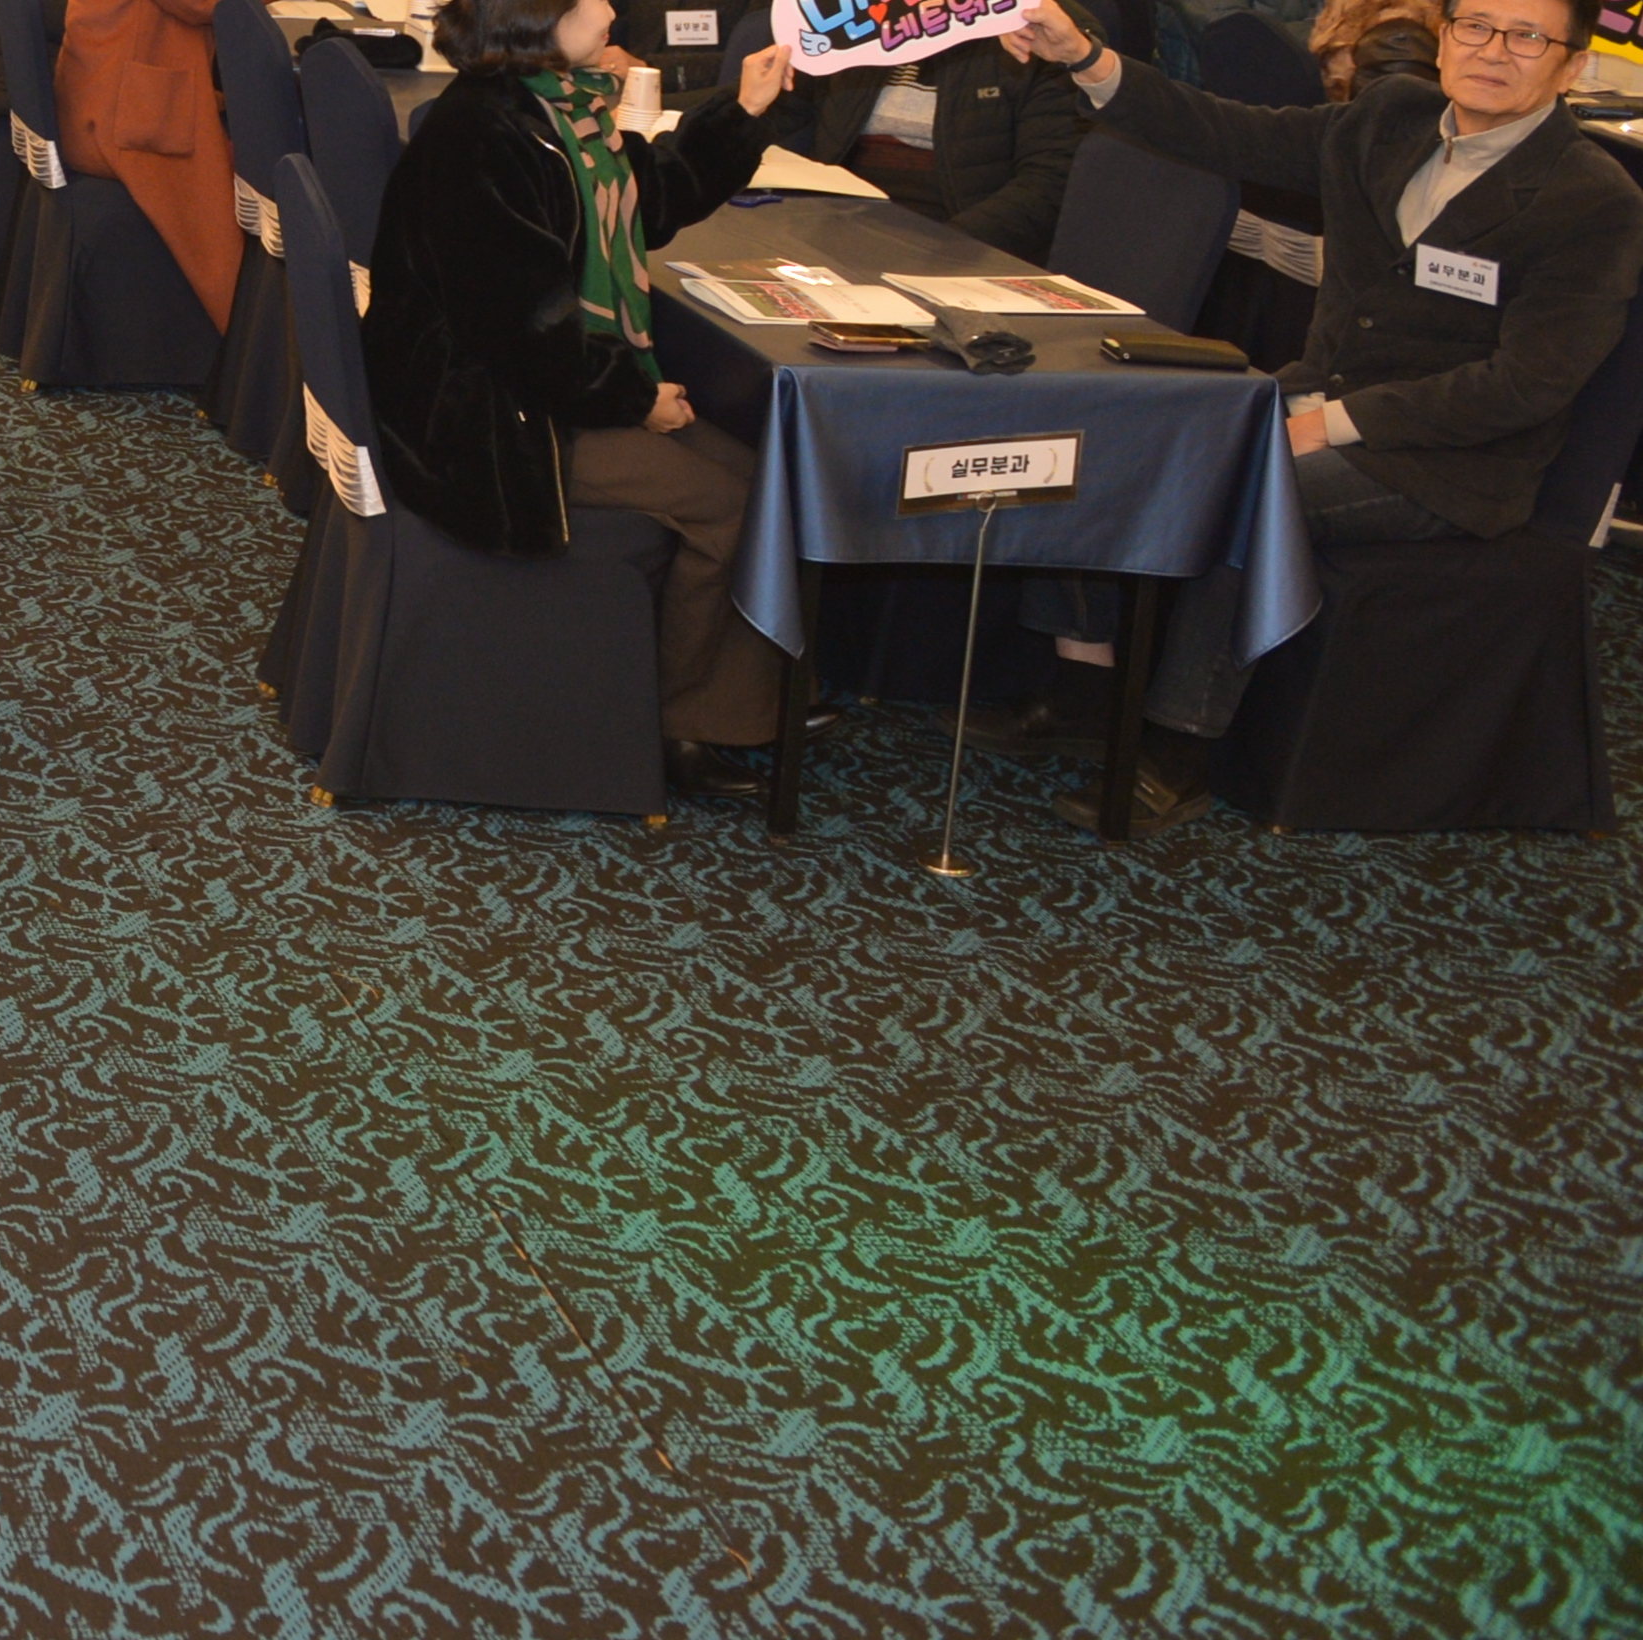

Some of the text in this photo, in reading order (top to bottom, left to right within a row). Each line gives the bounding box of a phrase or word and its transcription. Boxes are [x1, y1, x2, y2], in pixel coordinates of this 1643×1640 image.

[977, 86, 1000, 99] K2
[1428, 262, 1485, 285] 실무분과
[951, 454, 1030, 479] 실무분과
